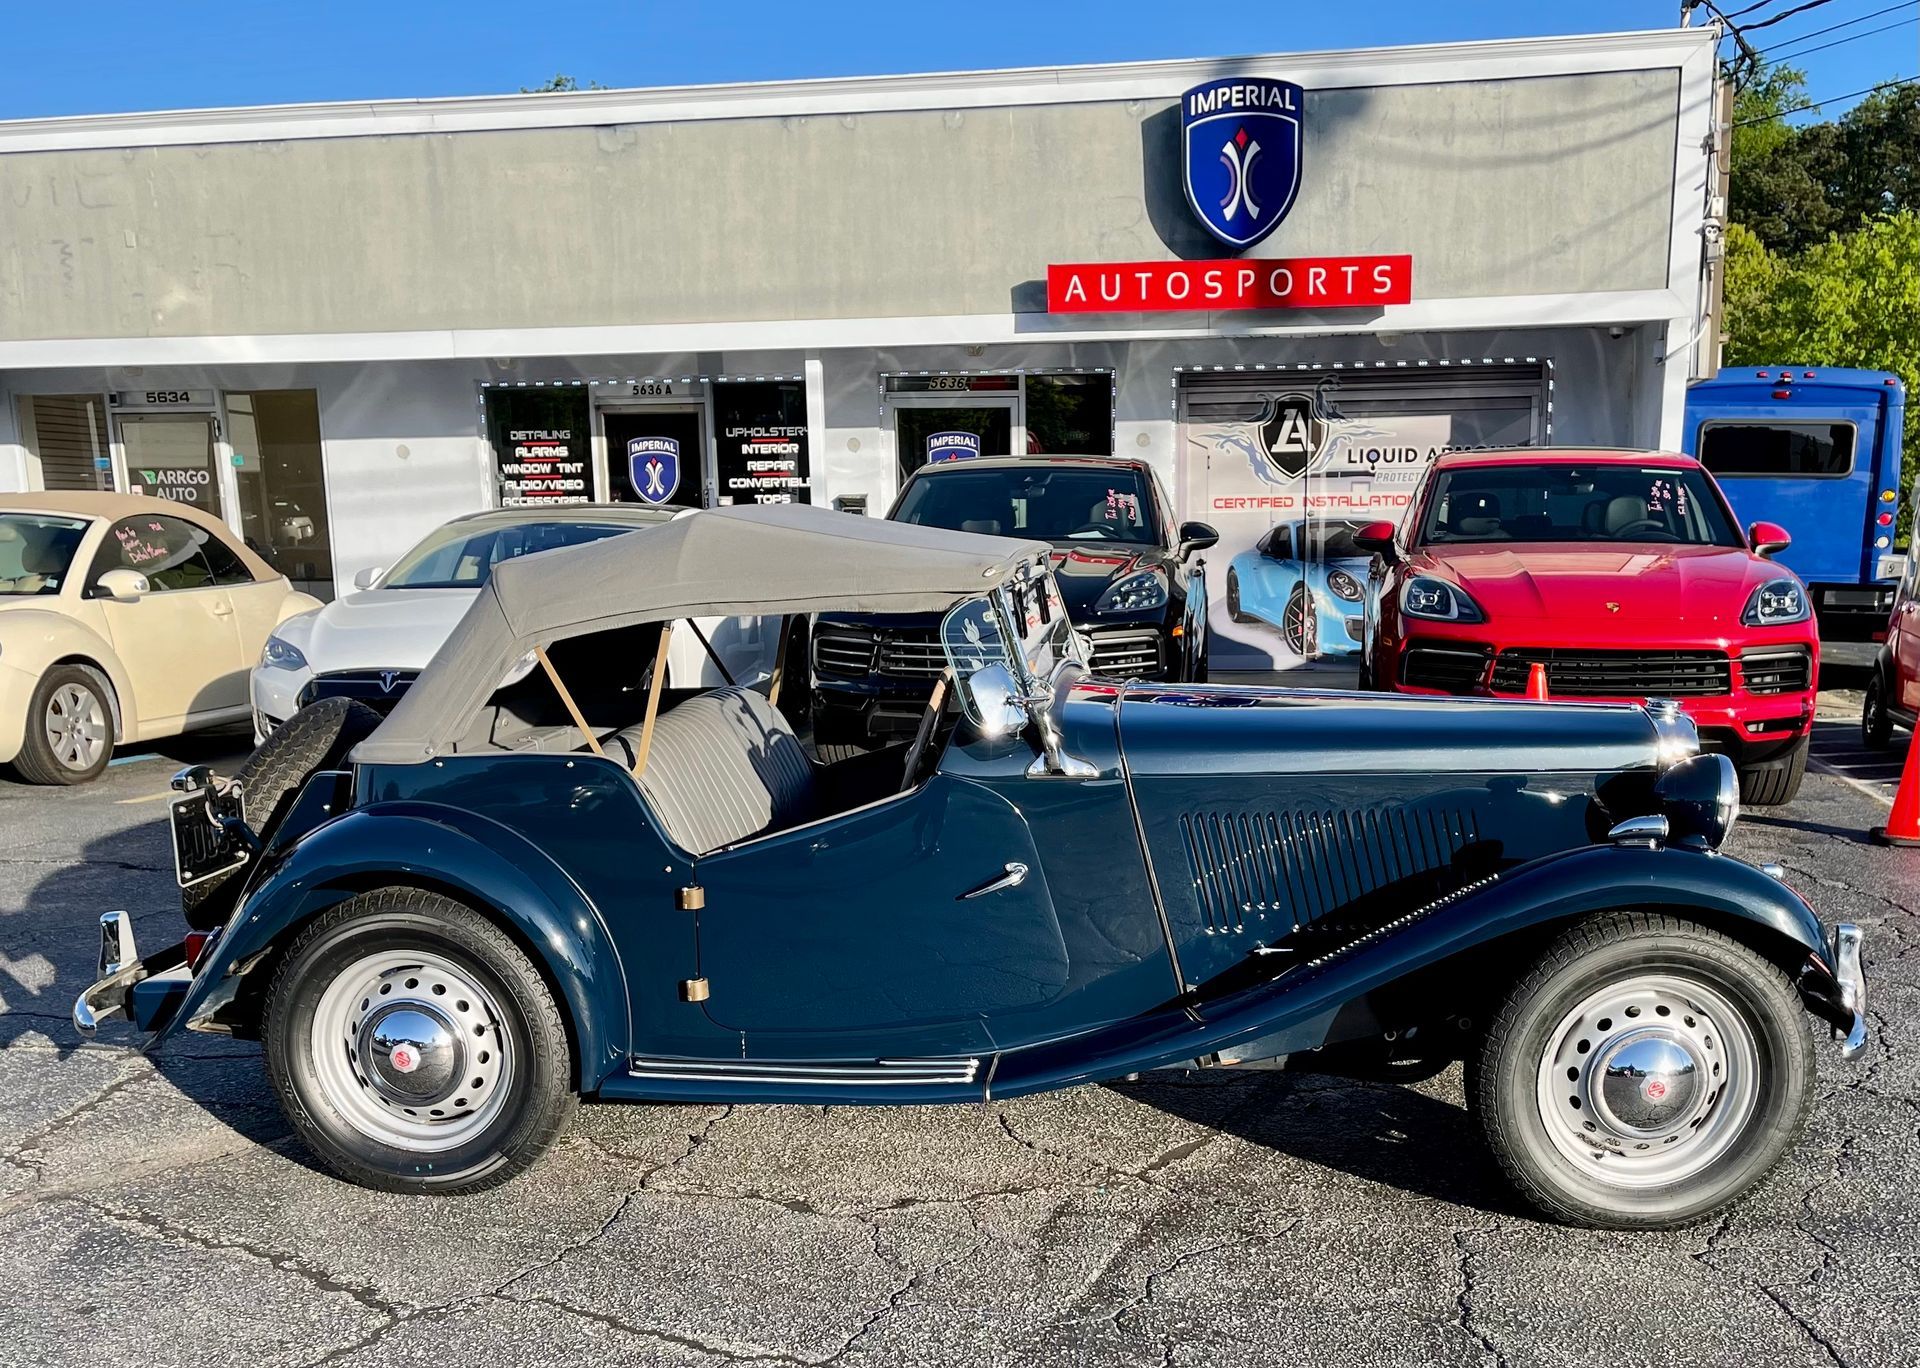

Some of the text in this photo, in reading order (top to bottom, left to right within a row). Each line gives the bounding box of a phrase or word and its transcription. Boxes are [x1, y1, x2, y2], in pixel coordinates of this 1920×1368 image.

[1190, 85, 1295, 116] IMPERIAL
[1064, 265, 1392, 303] AUTOSPORTS
[930, 376, 965, 389] 5636
[632, 384, 673, 395] 5636 A
[146, 391, 190, 403] 5634
[510, 430, 571, 440] DETAILING
[631, 440, 676, 453] IMPERIAL
[930, 435, 977, 448] IMPERIAL
[515, 446, 569, 458] ALARMS
[741, 443, 799, 455] INTERIOR
[1347, 448, 1418, 470] LIQUID
[502, 462, 584, 474] WINDOW TINT
[747, 460, 795, 471] REPAIR
[1375, 472, 1424, 482] PROTECT
[505, 479, 584, 491] AUDIO/VIDEO
[156, 488, 197, 501] AUTO
[754, 494, 791, 505] TOPS
[502, 496, 589, 507] ACCESSORIES
[1213, 497, 1294, 509] CERTIFIED
